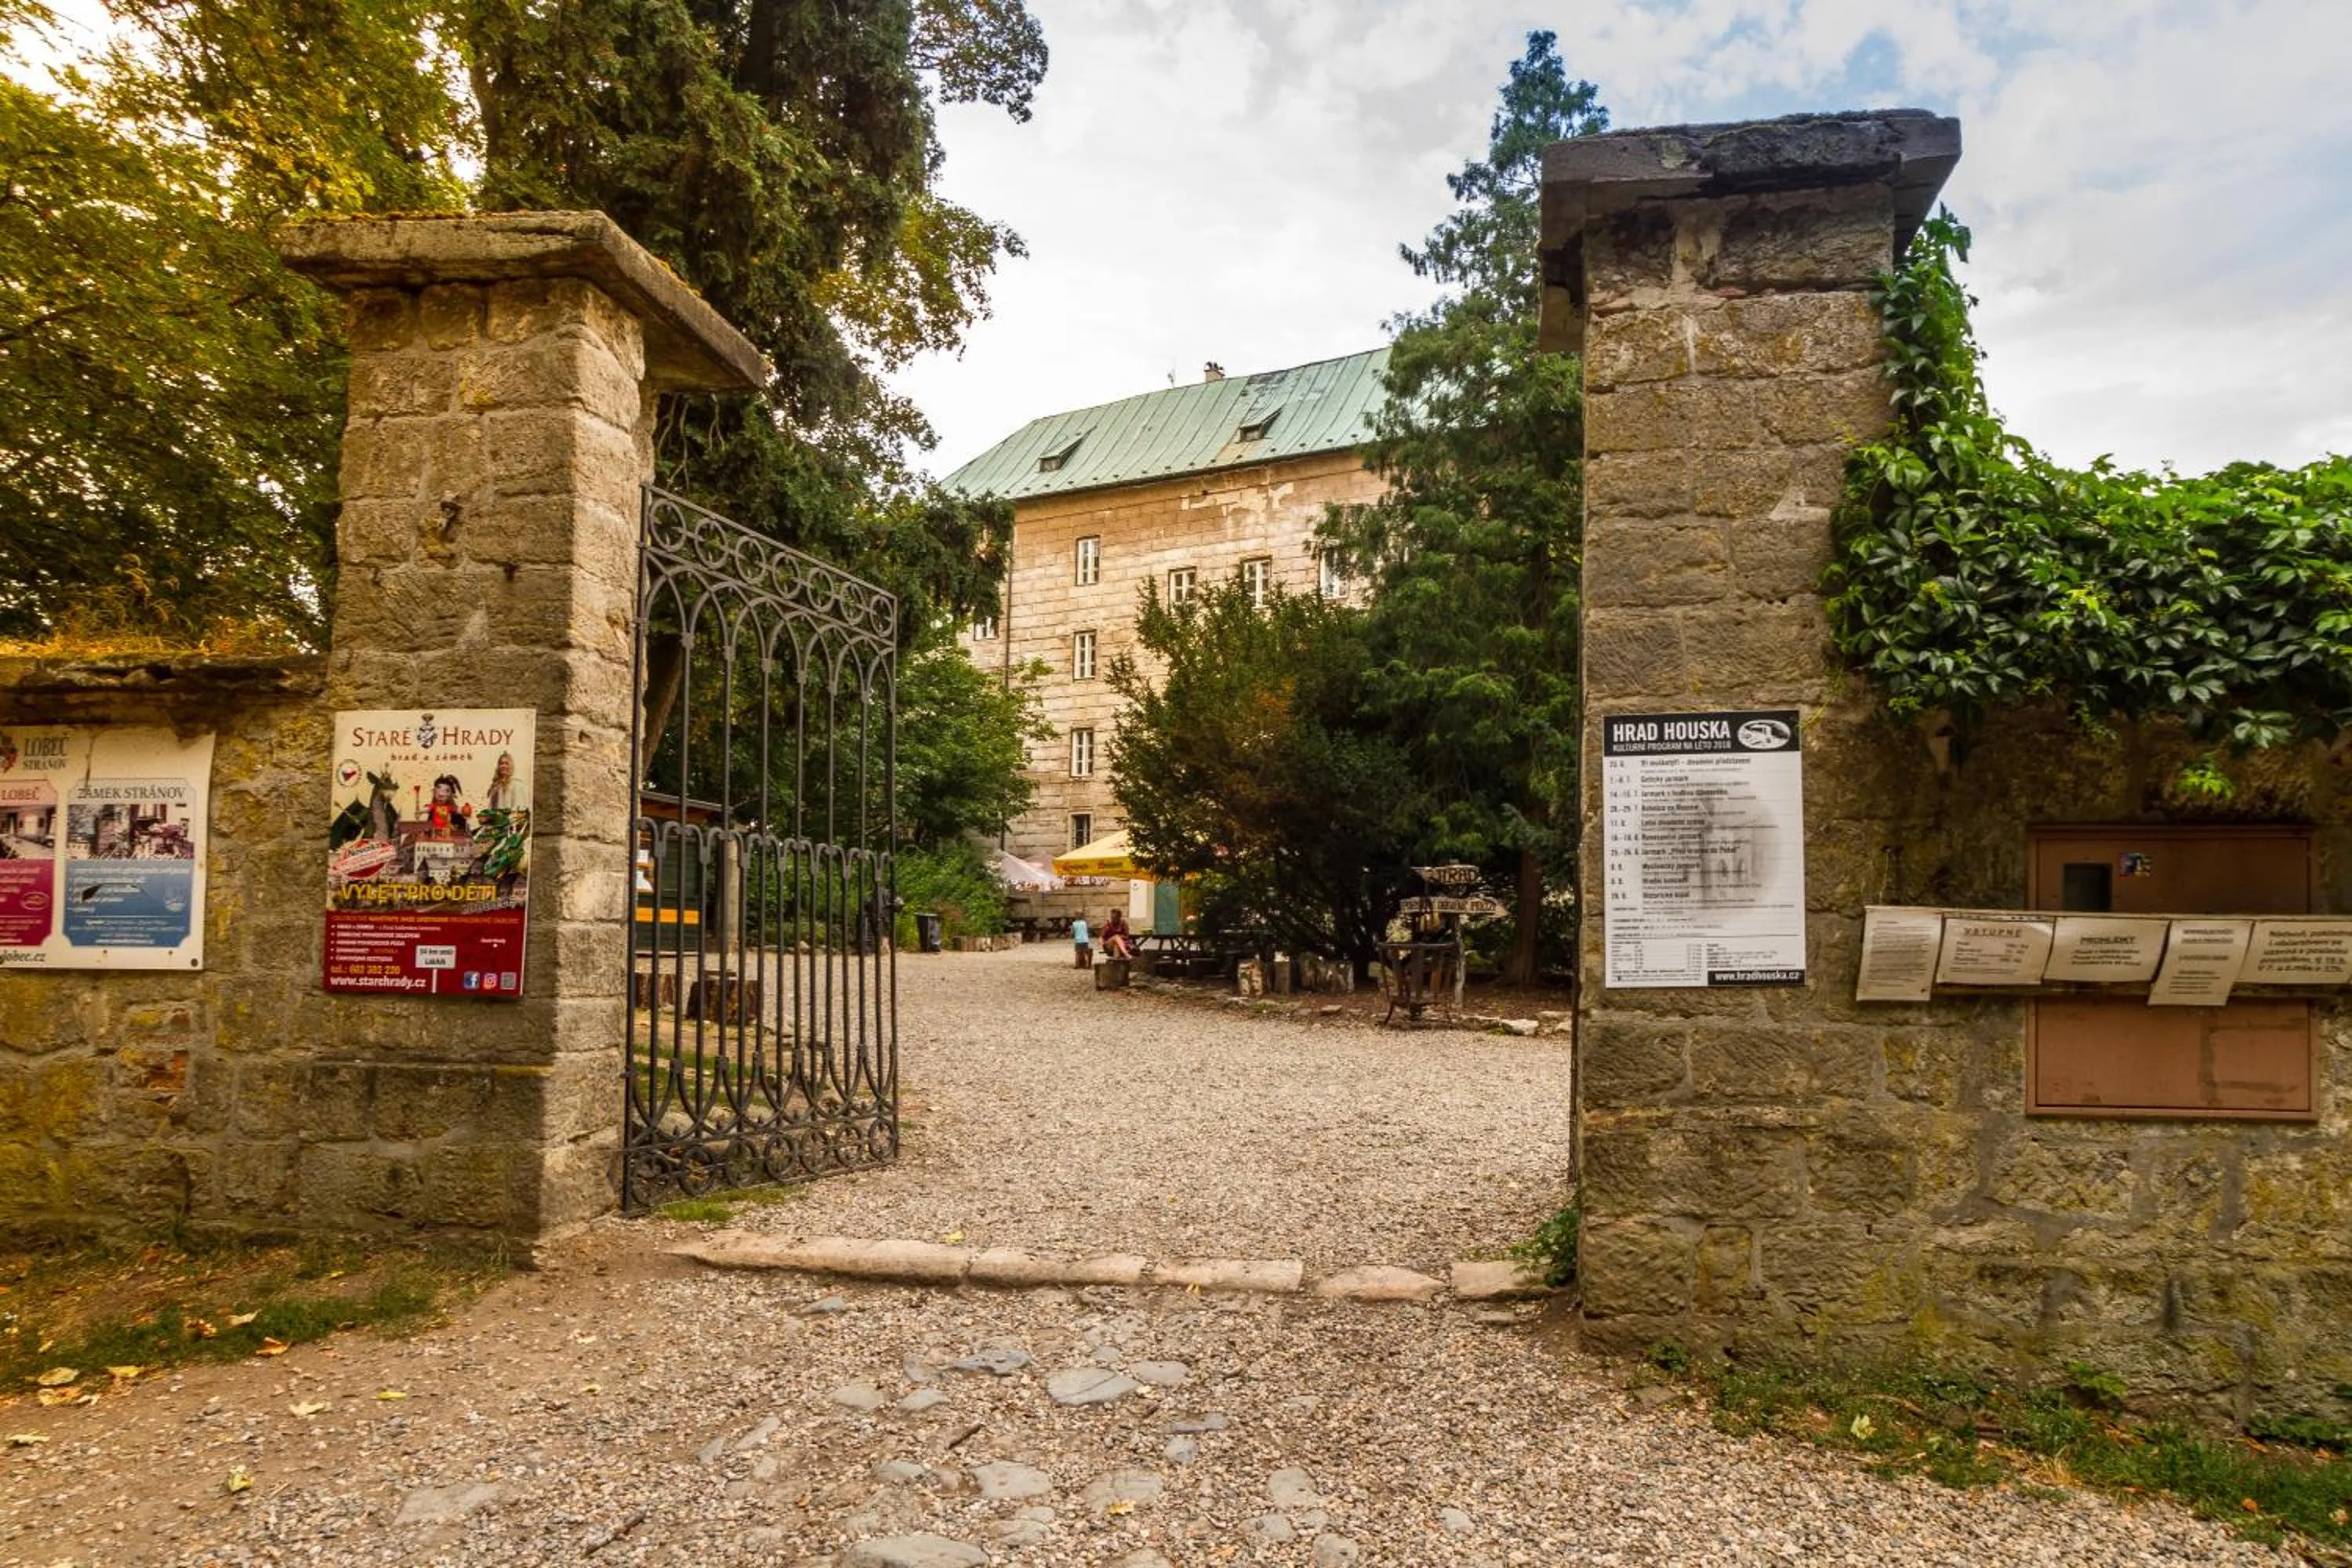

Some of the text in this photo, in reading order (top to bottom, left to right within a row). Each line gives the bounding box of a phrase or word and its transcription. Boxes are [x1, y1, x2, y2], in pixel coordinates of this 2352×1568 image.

[352, 727, 514, 746] STARÉ HRADY
[1613, 720, 1732, 742] HRAD HOUSKA
[24, 733, 70, 757] LOBEČ
[1613, 742, 1646, 753] KULTURNÍ
[1648, 742, 1682, 751] PROGRAM
[1695, 740, 1711, 750] LÉTO
[1713, 741, 1731, 750] 2018
[2, 786, 40, 800] LOBEČ
[77, 785, 187, 799] ZÁMEK STRÁNOV
[341, 881, 498, 902] VÝLET PRO DĚTI
